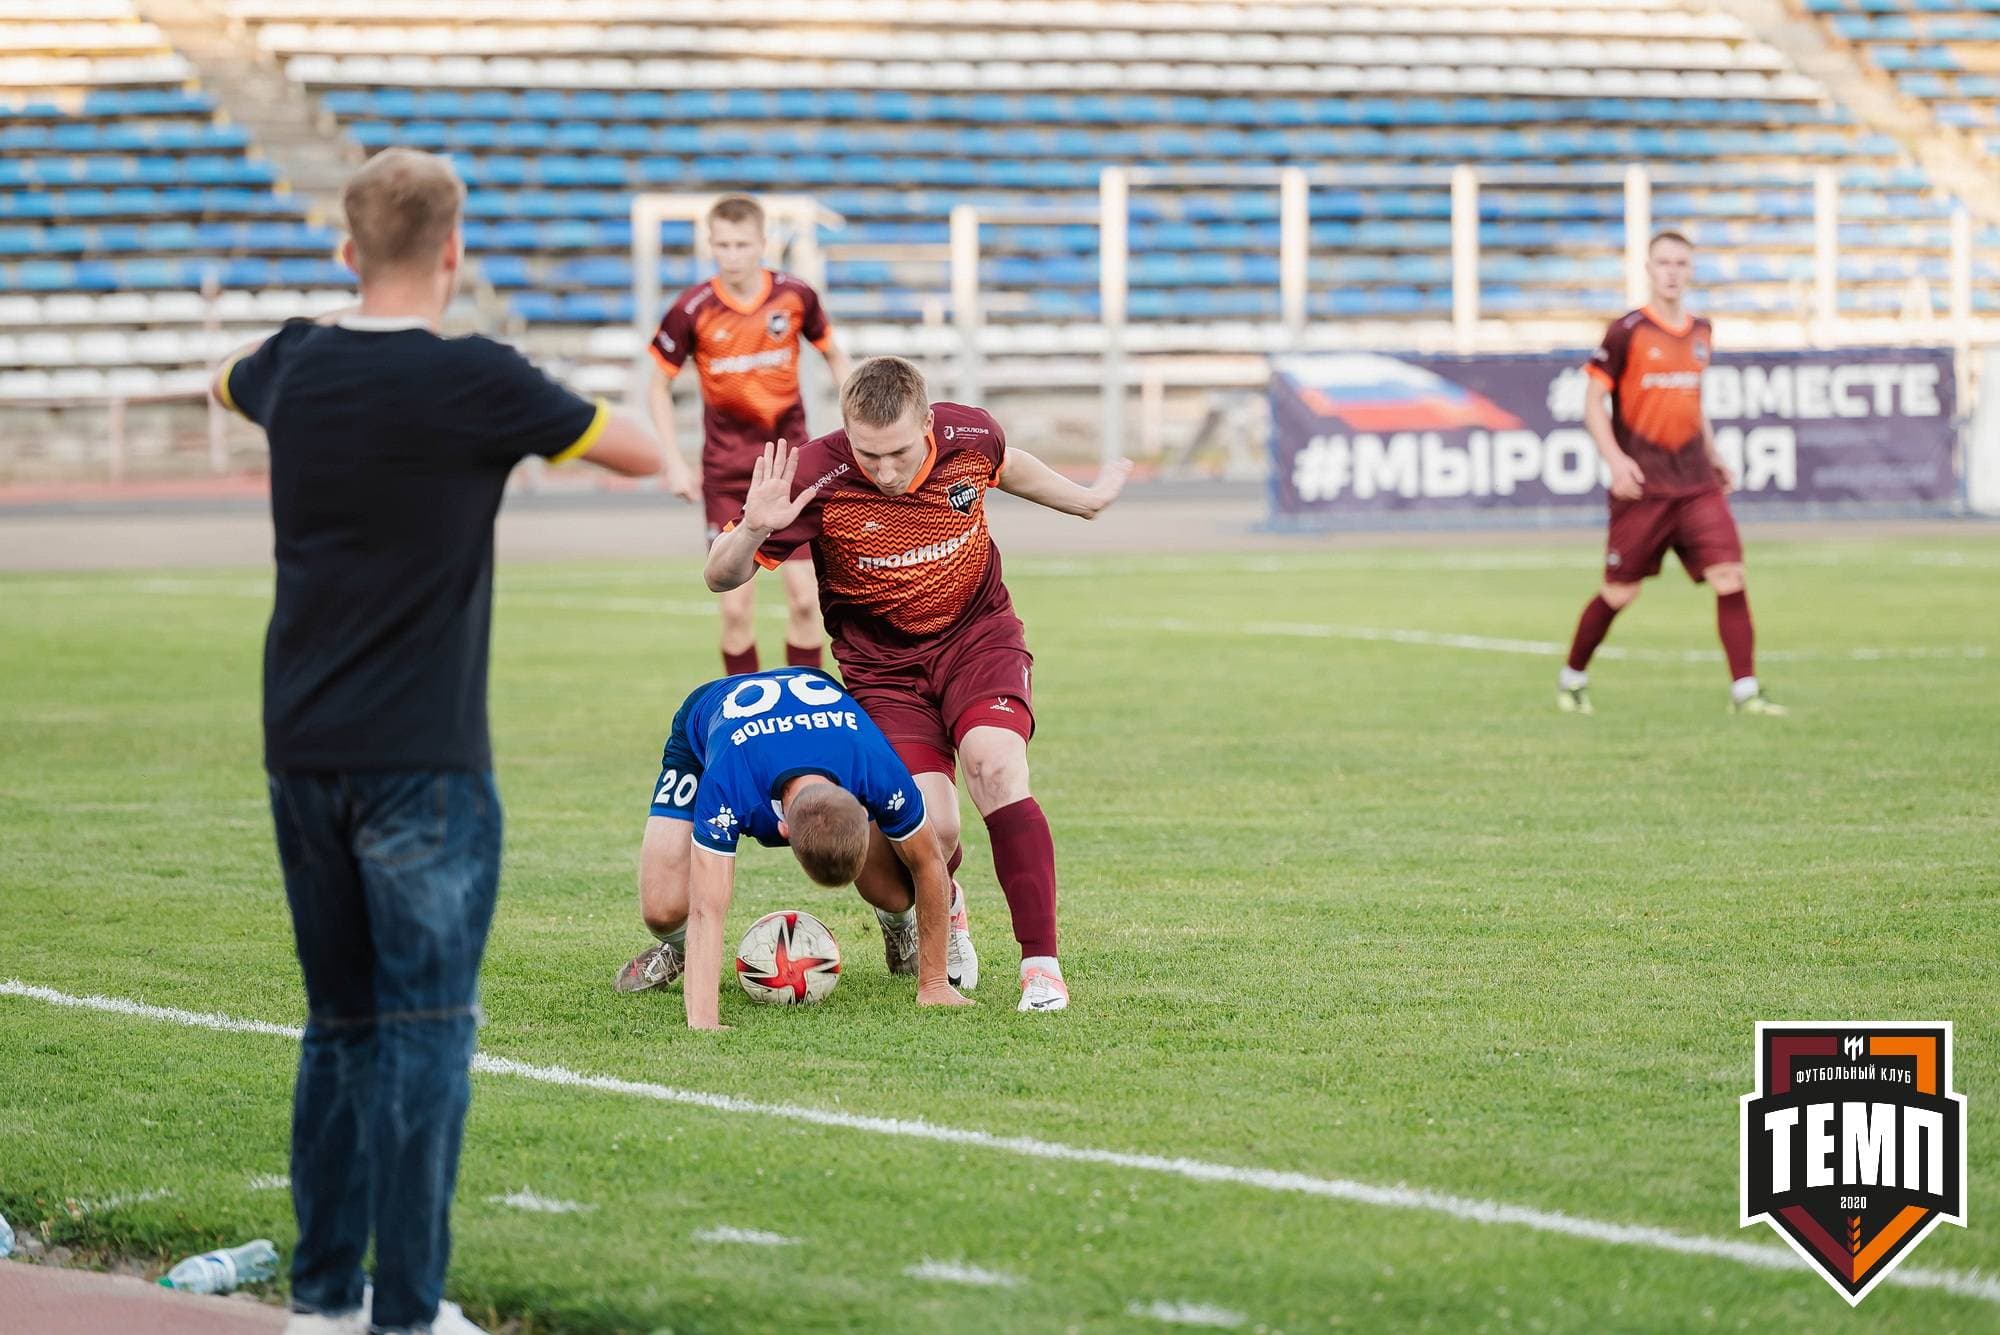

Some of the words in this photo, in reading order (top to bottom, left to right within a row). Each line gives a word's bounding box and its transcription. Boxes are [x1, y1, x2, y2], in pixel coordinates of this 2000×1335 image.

[1547, 363, 1940, 422] #ВМЕСТЕ
[1292, 426, 1797, 502] #МЫРОЯ
[731, 711, 858, 746] ЗАВЬЯЛОВ
[655, 769, 698, 806] 20
